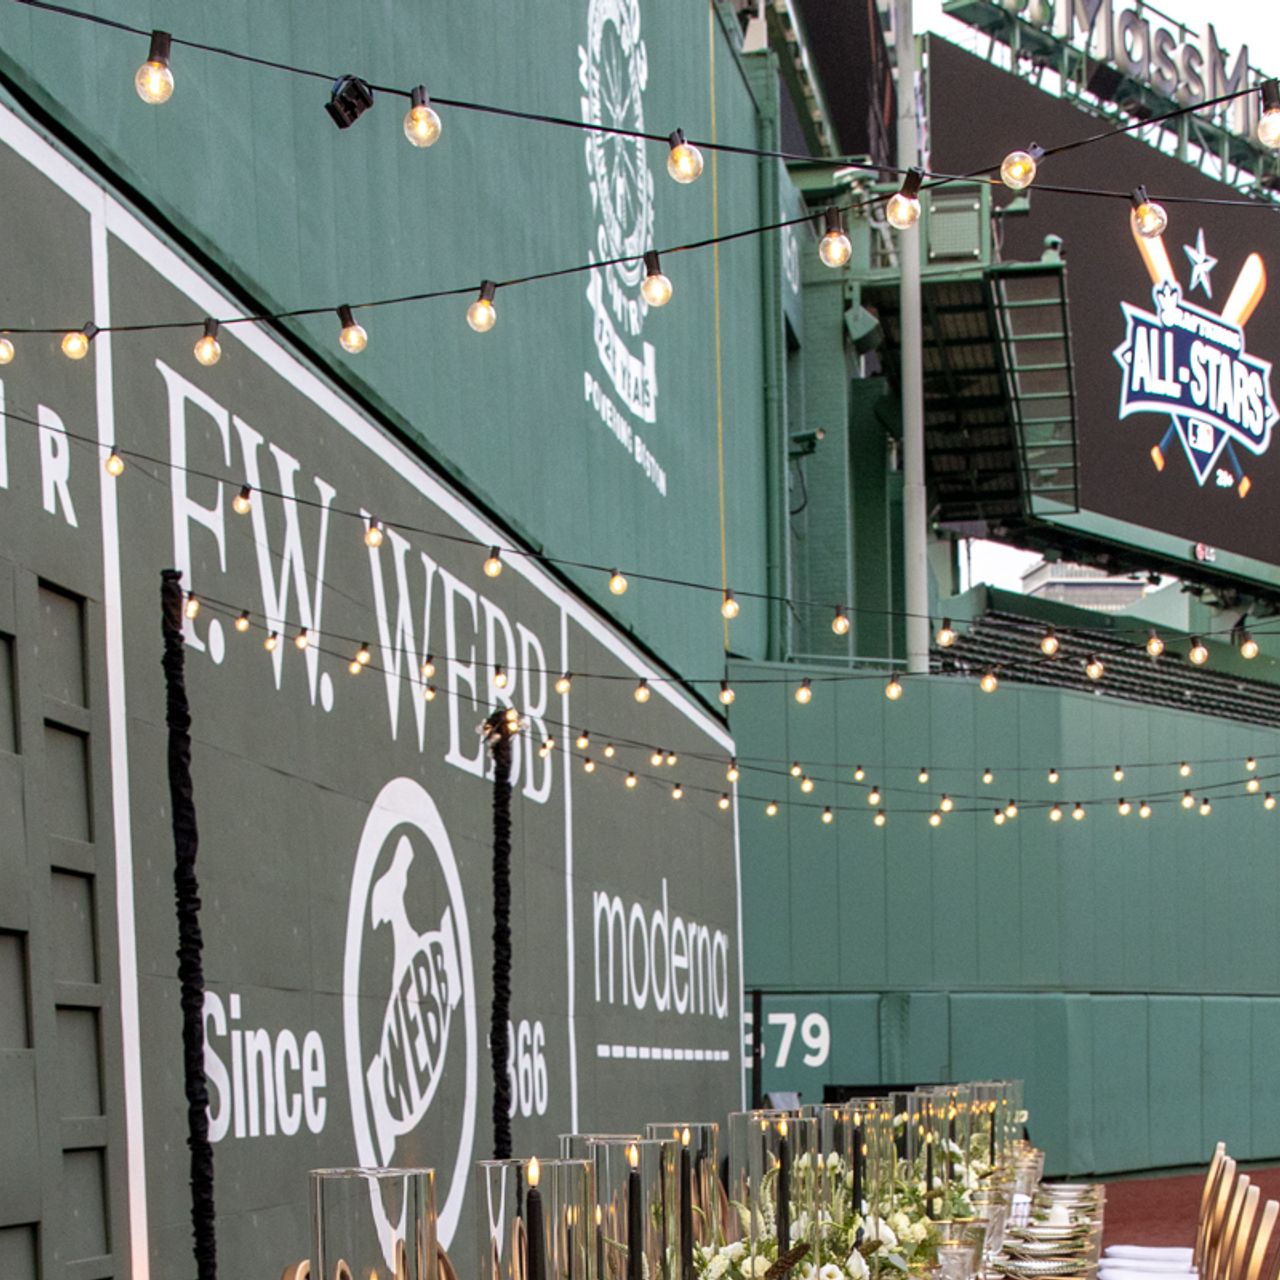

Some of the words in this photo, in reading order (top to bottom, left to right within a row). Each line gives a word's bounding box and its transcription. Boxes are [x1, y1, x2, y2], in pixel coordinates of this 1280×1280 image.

[1131, 325, 1265, 437] ALL-STARS
[37, 402, 79, 528] R
[360, 507, 553, 805] WEBB
[593, 877, 728, 1019] moderna
[202, 990, 327, 1142] Since
[382, 940, 451, 1123] WEBB
